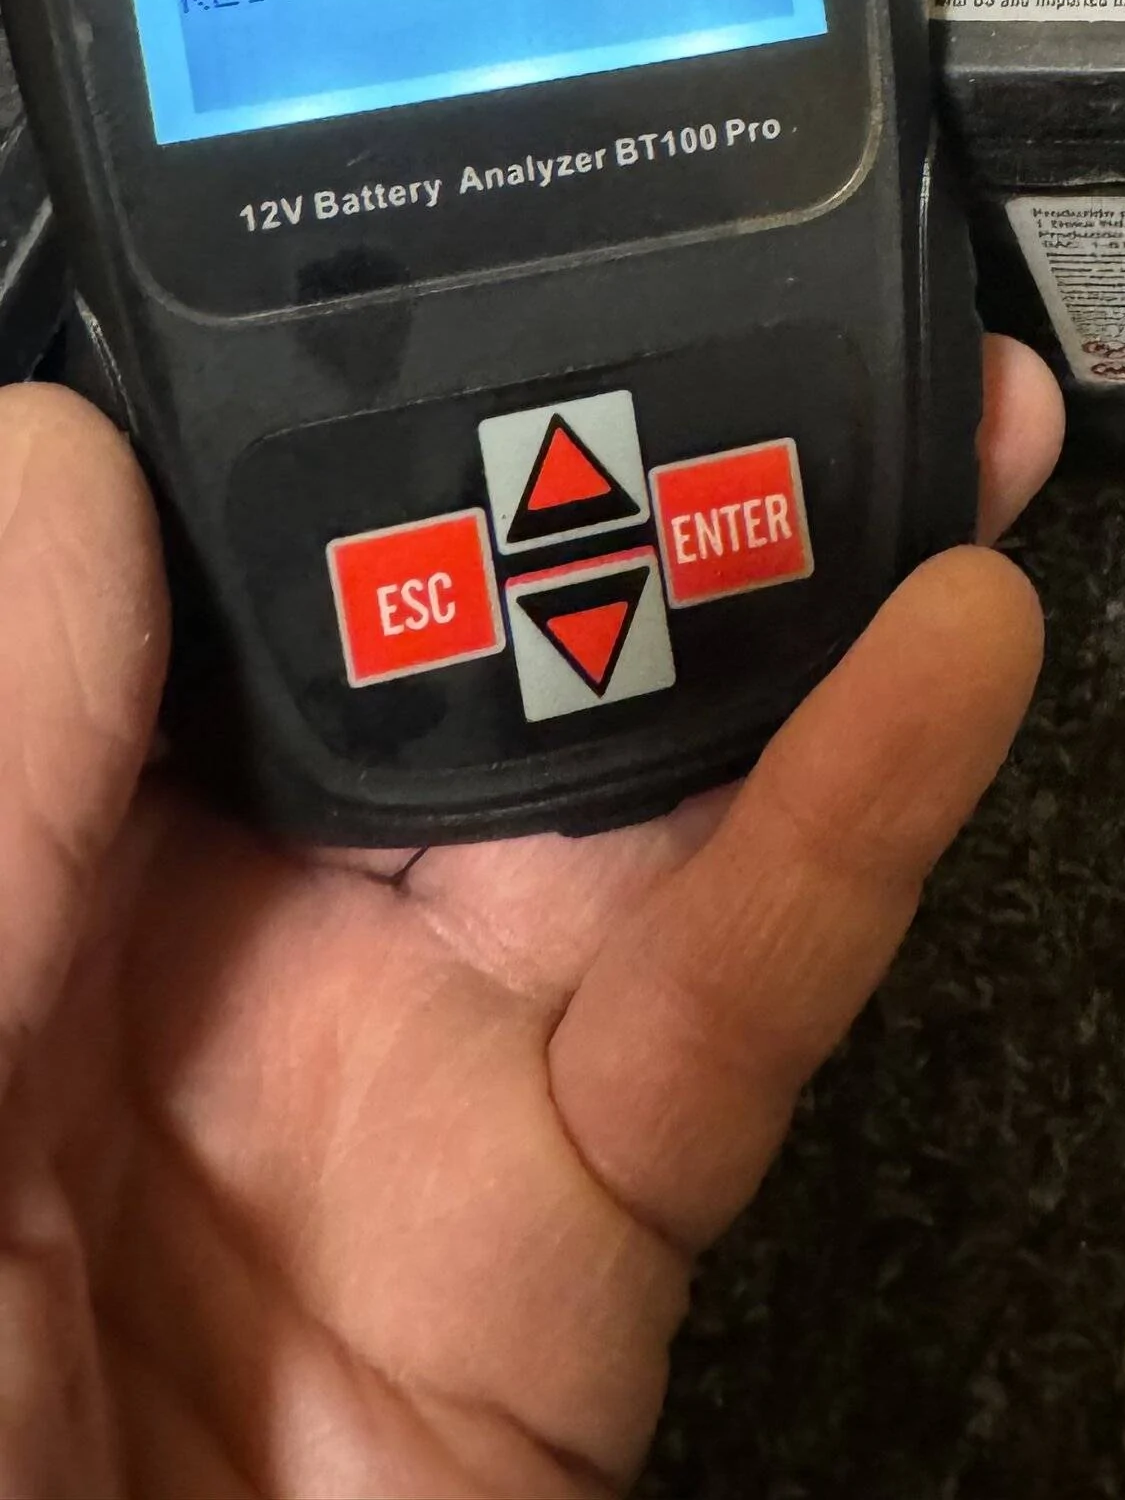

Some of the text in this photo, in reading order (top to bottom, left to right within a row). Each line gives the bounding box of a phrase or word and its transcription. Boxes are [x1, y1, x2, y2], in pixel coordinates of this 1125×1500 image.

[240, 117, 782, 235] 12V Battery Analyzer BT100 Pro
[671, 492, 794, 566] ENTER
[375, 571, 457, 637] ESC
